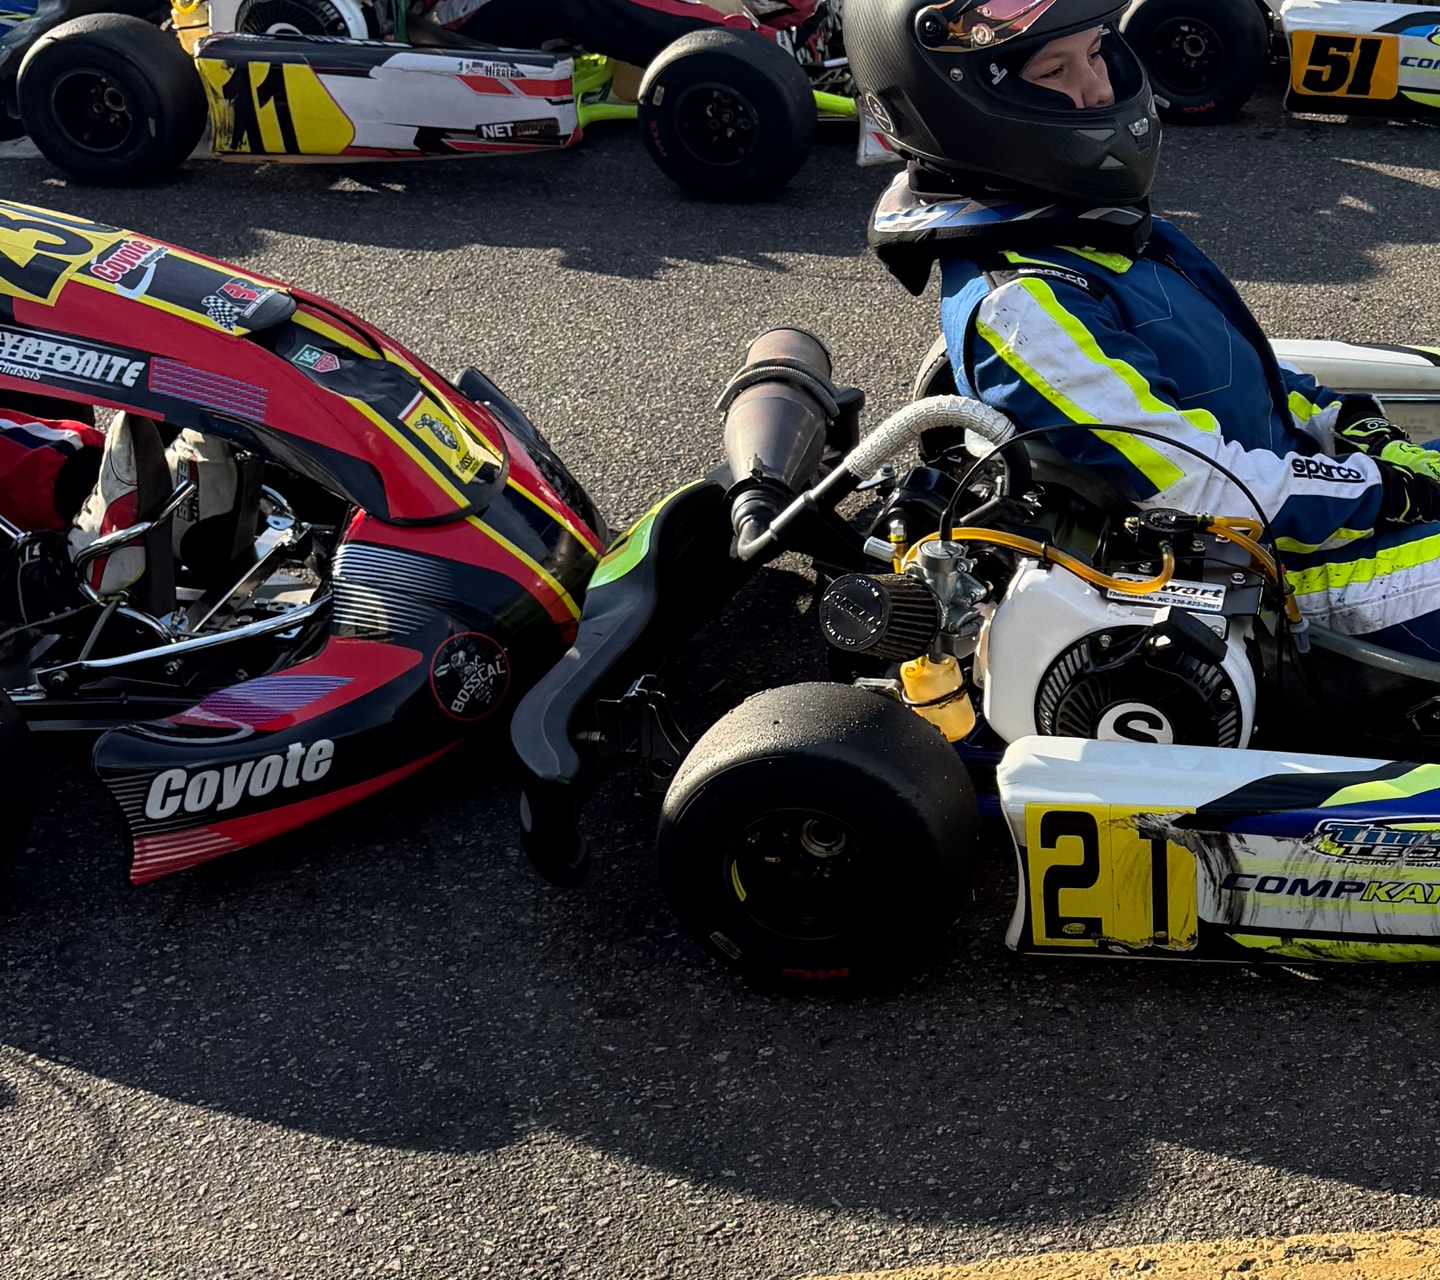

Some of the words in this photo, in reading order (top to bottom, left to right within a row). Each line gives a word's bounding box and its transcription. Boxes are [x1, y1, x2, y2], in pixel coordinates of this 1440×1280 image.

[1302, 34, 1383, 97] 51
[219, 61, 303, 154] 11
[481, 122, 515, 139] NET
[91, 238, 154, 282] Coyote
[1291, 458, 1366, 484] sparco
[144, 739, 336, 819] Coyote
[1040, 809, 1169, 946] 21
